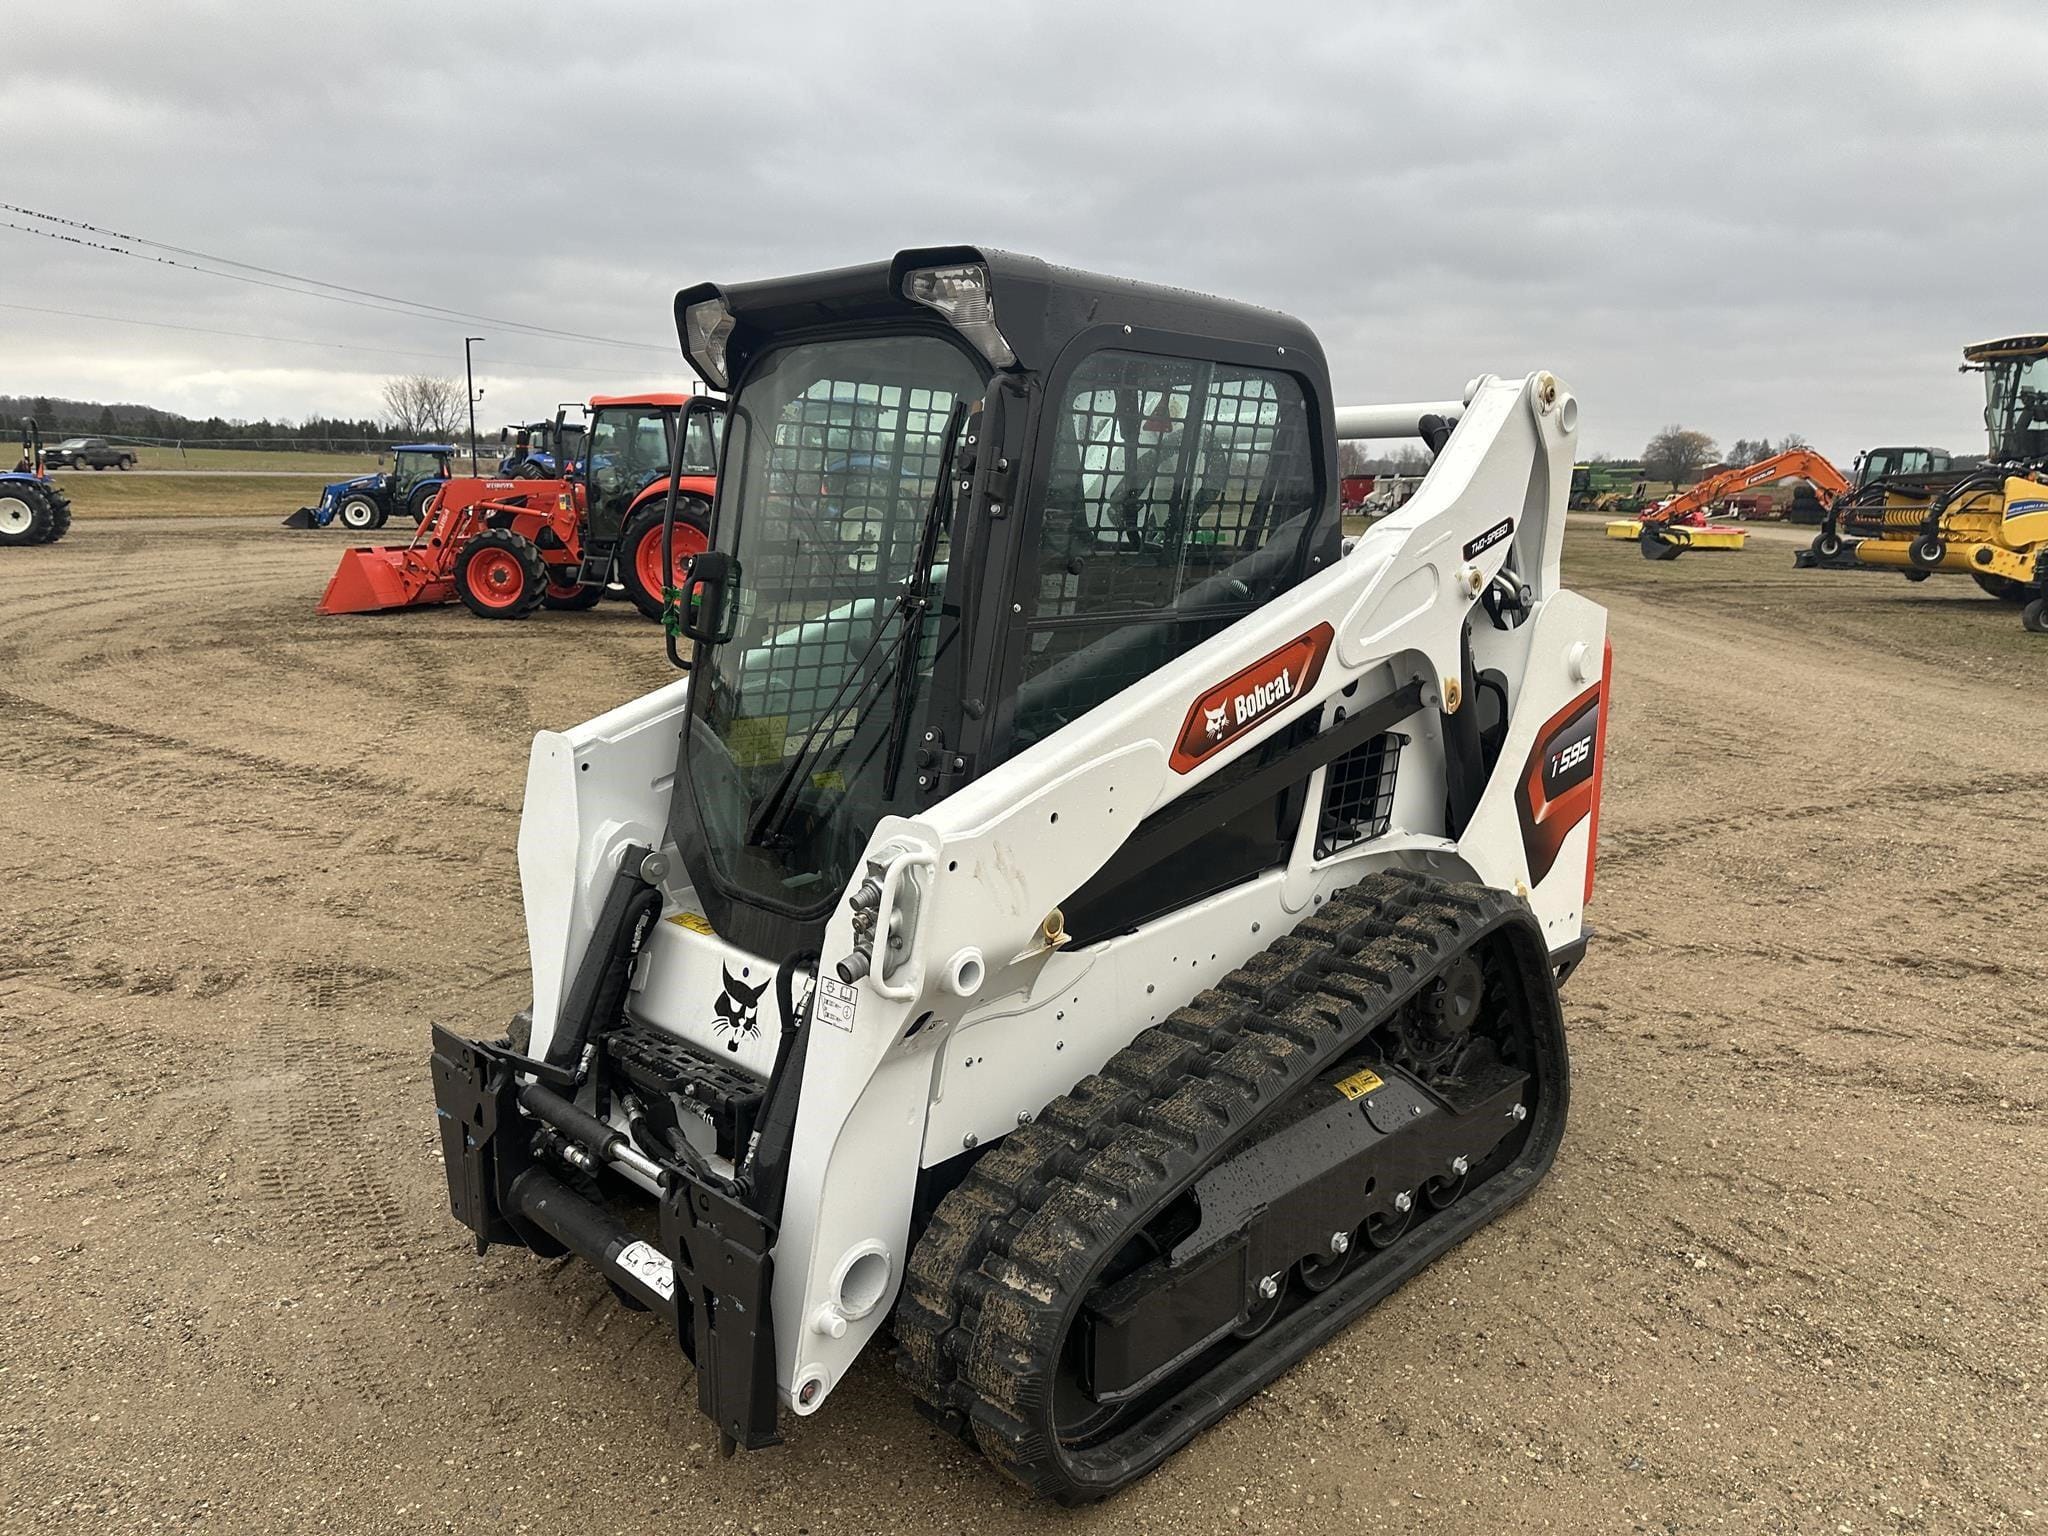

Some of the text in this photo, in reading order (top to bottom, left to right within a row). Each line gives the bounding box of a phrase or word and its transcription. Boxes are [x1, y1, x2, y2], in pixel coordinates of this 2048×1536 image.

[1471, 523, 1508, 554] TWO-SPEED
[1234, 667, 1291, 726] Bobcat
[1551, 735, 1591, 778] T595
